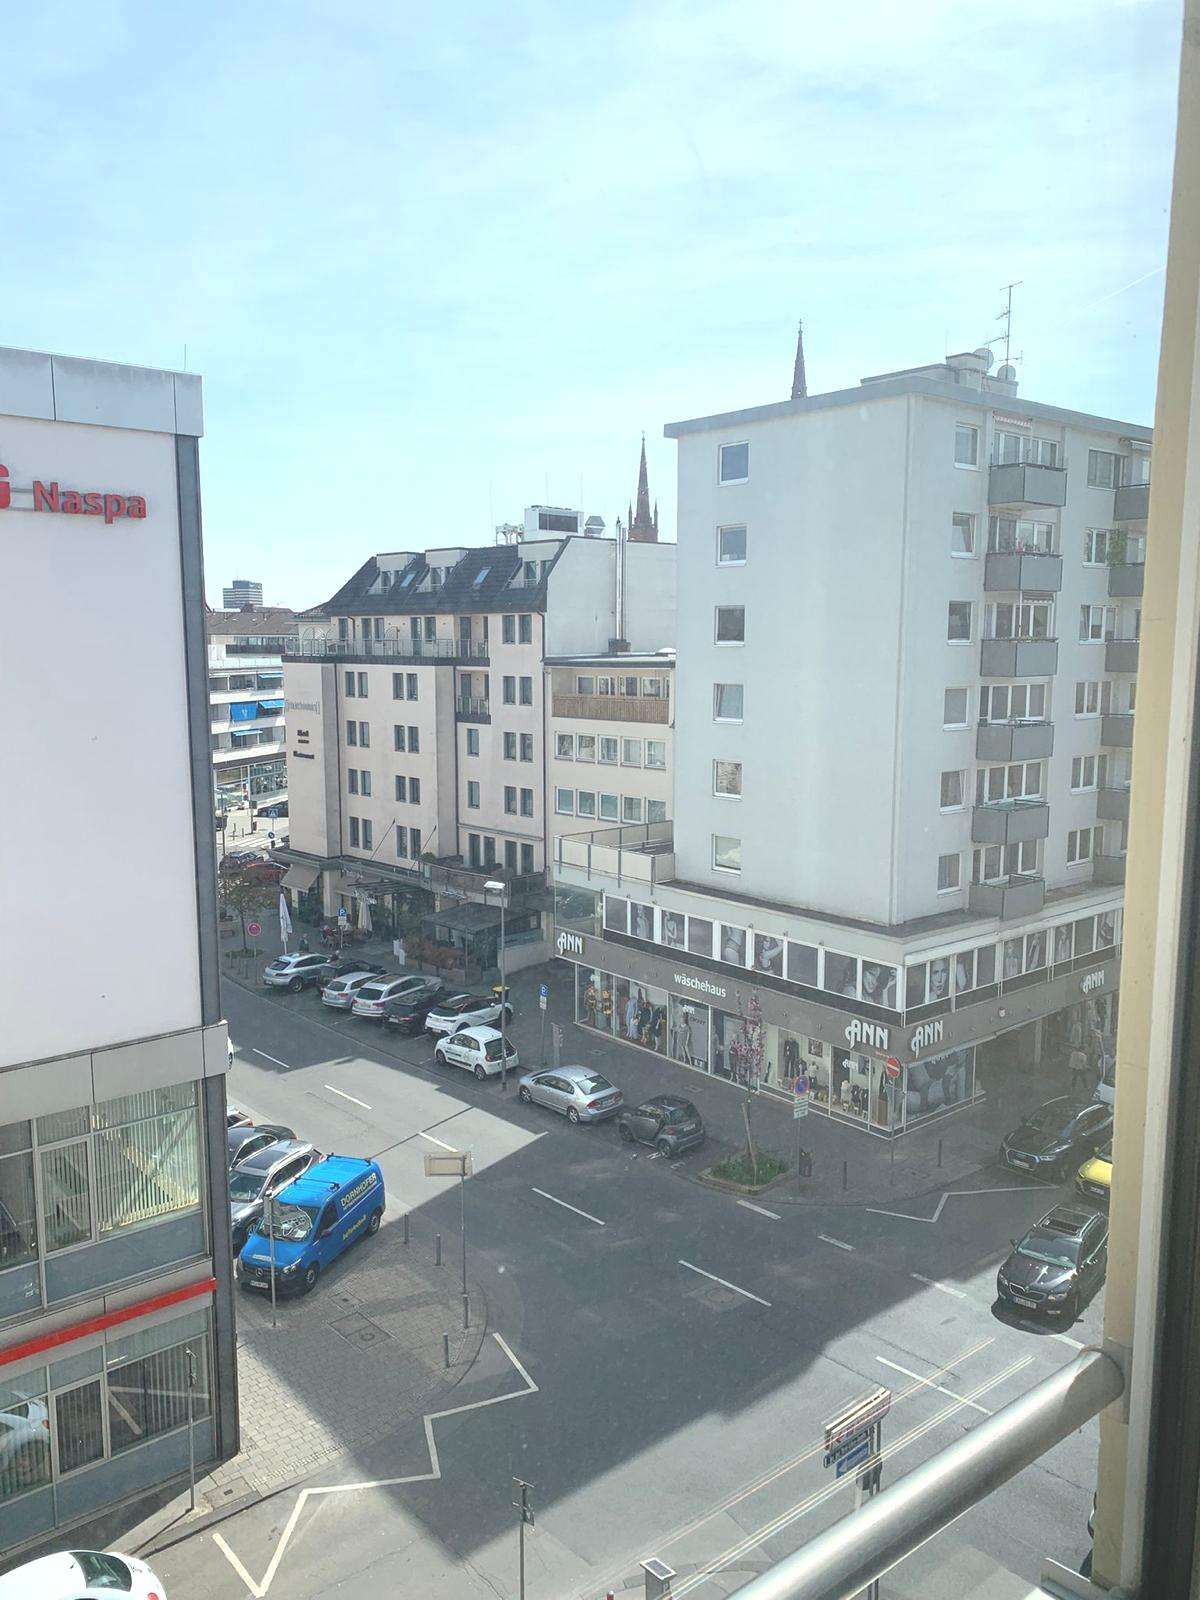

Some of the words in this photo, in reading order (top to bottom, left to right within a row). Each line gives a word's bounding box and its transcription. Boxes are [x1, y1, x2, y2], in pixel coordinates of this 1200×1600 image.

[32, 480, 147, 525] Naspa
[557, 932, 583, 955] ANN
[674, 974, 727, 998] wäschehaus
[844, 1019, 889, 1050] ANN
[911, 1020, 944, 1059] ANN
[340, 1172, 377, 1207] DORNHOFER
